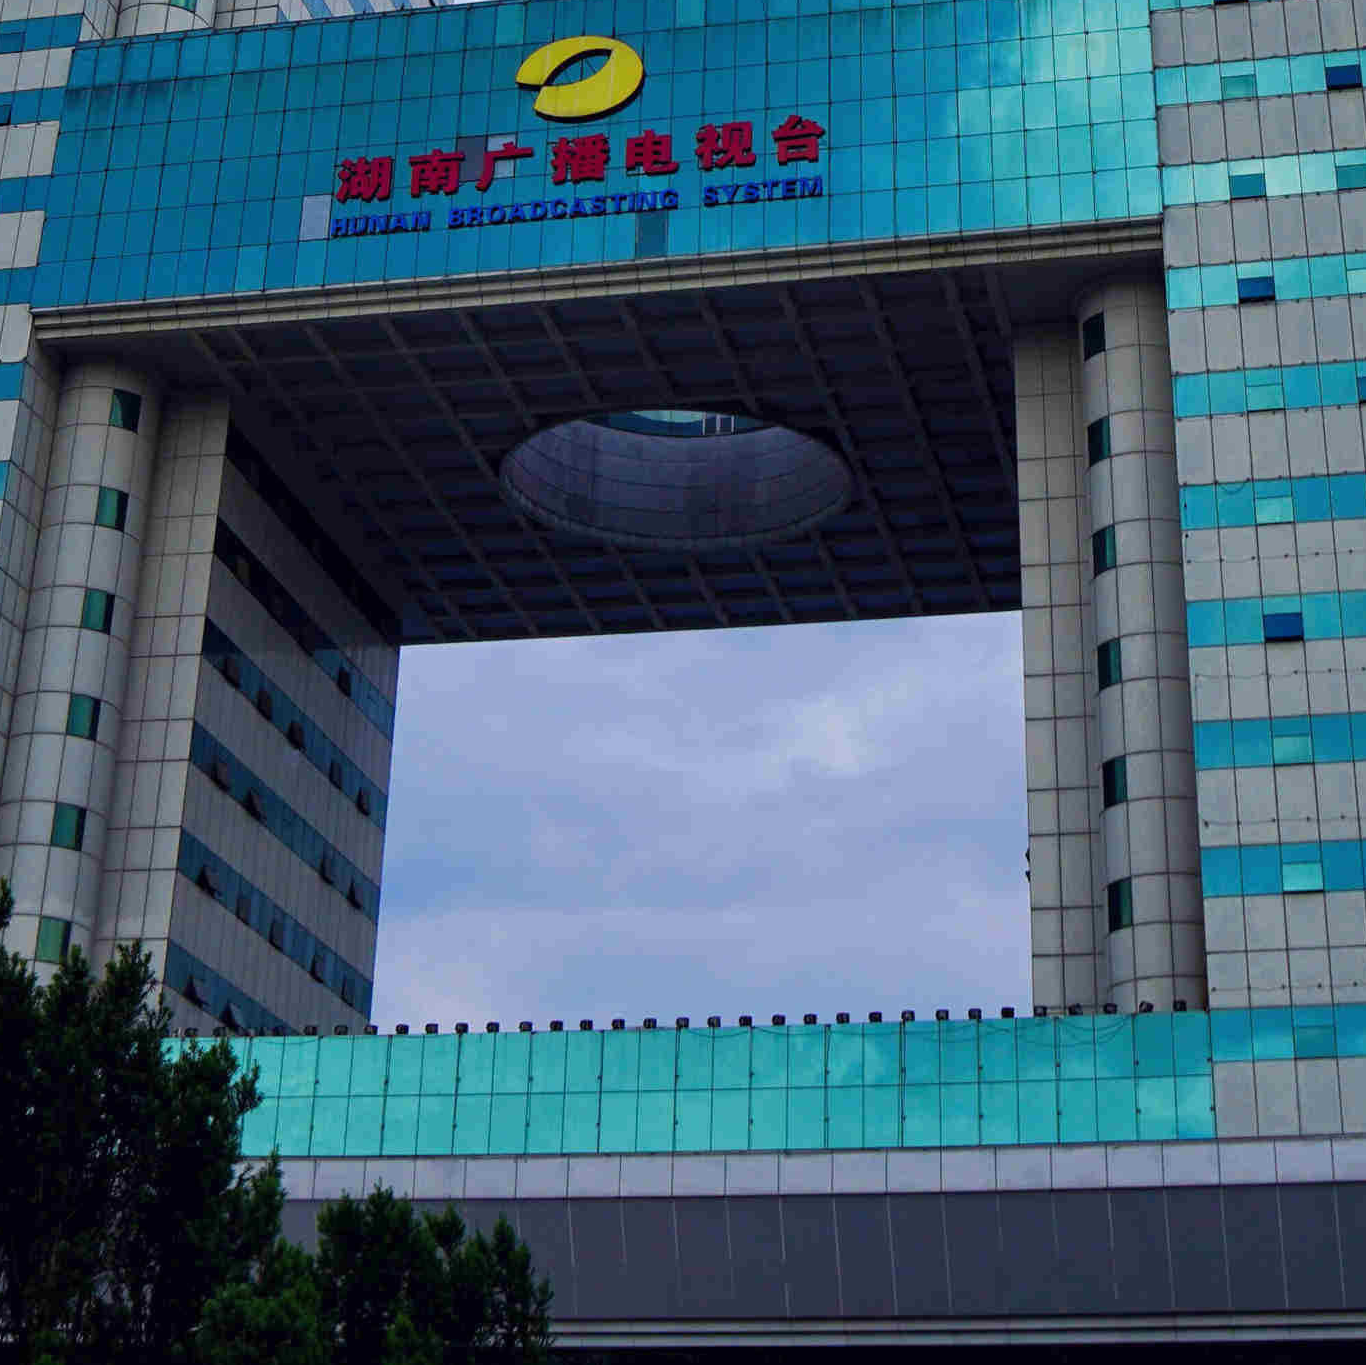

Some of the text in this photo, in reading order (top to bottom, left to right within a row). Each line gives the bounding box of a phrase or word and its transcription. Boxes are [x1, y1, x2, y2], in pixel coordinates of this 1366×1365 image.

[335, 115, 826, 203] 湖南广播电视台
[331, 176, 823, 236] HUNAN BROADCASTING SYSTEM
